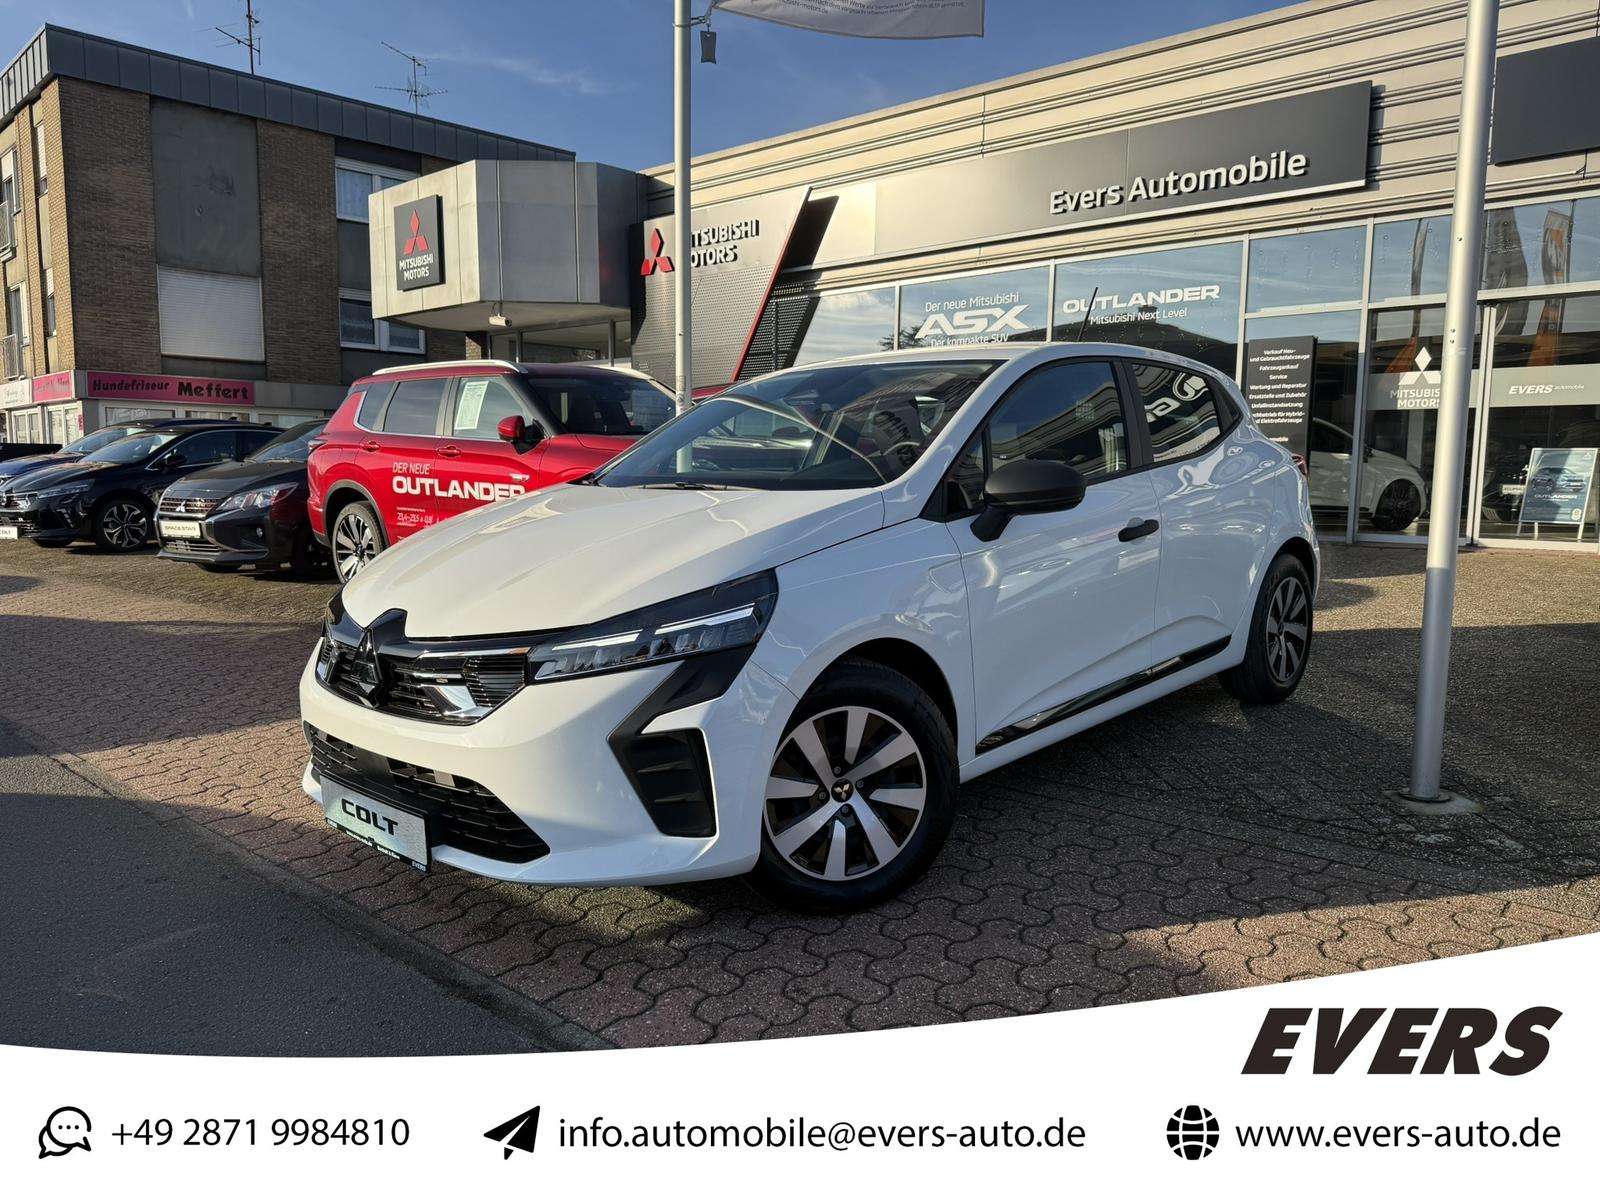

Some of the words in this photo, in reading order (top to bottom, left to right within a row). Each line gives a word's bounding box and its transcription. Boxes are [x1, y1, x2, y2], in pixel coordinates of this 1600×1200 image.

[1049, 184, 1126, 214] Evers
[1128, 150, 1311, 204] Automobile
[691, 219, 759, 247] TSUBISHI
[399, 254, 434, 270] MITSUBISHI
[690, 245, 738, 268] OTORS
[403, 267, 430, 281] MOTORS
[925, 301, 942, 312] Der
[943, 299, 967, 310] neue
[969, 291, 1019, 308] Mitsubishi
[1062, 284, 1221, 313] OUTLANDER
[914, 303, 1030, 339] ASX
[1090, 312, 1136, 325] Mitsubishi
[1137, 310, 1160, 321] Next
[1163, 307, 1188, 319] Level
[947, 335, 989, 347] kompakte
[991, 333, 1009, 345] SUV
[92, 378, 170, 392] Hundefriseur
[177, 381, 249, 400] Meffert
[1390, 388, 1441, 399] MITSUBIS
[1508, 384, 1553, 395] EVERS
[392, 461, 408, 473] DER
[409, 463, 431, 475] NEUE
[341, 798, 399, 836] COLT
